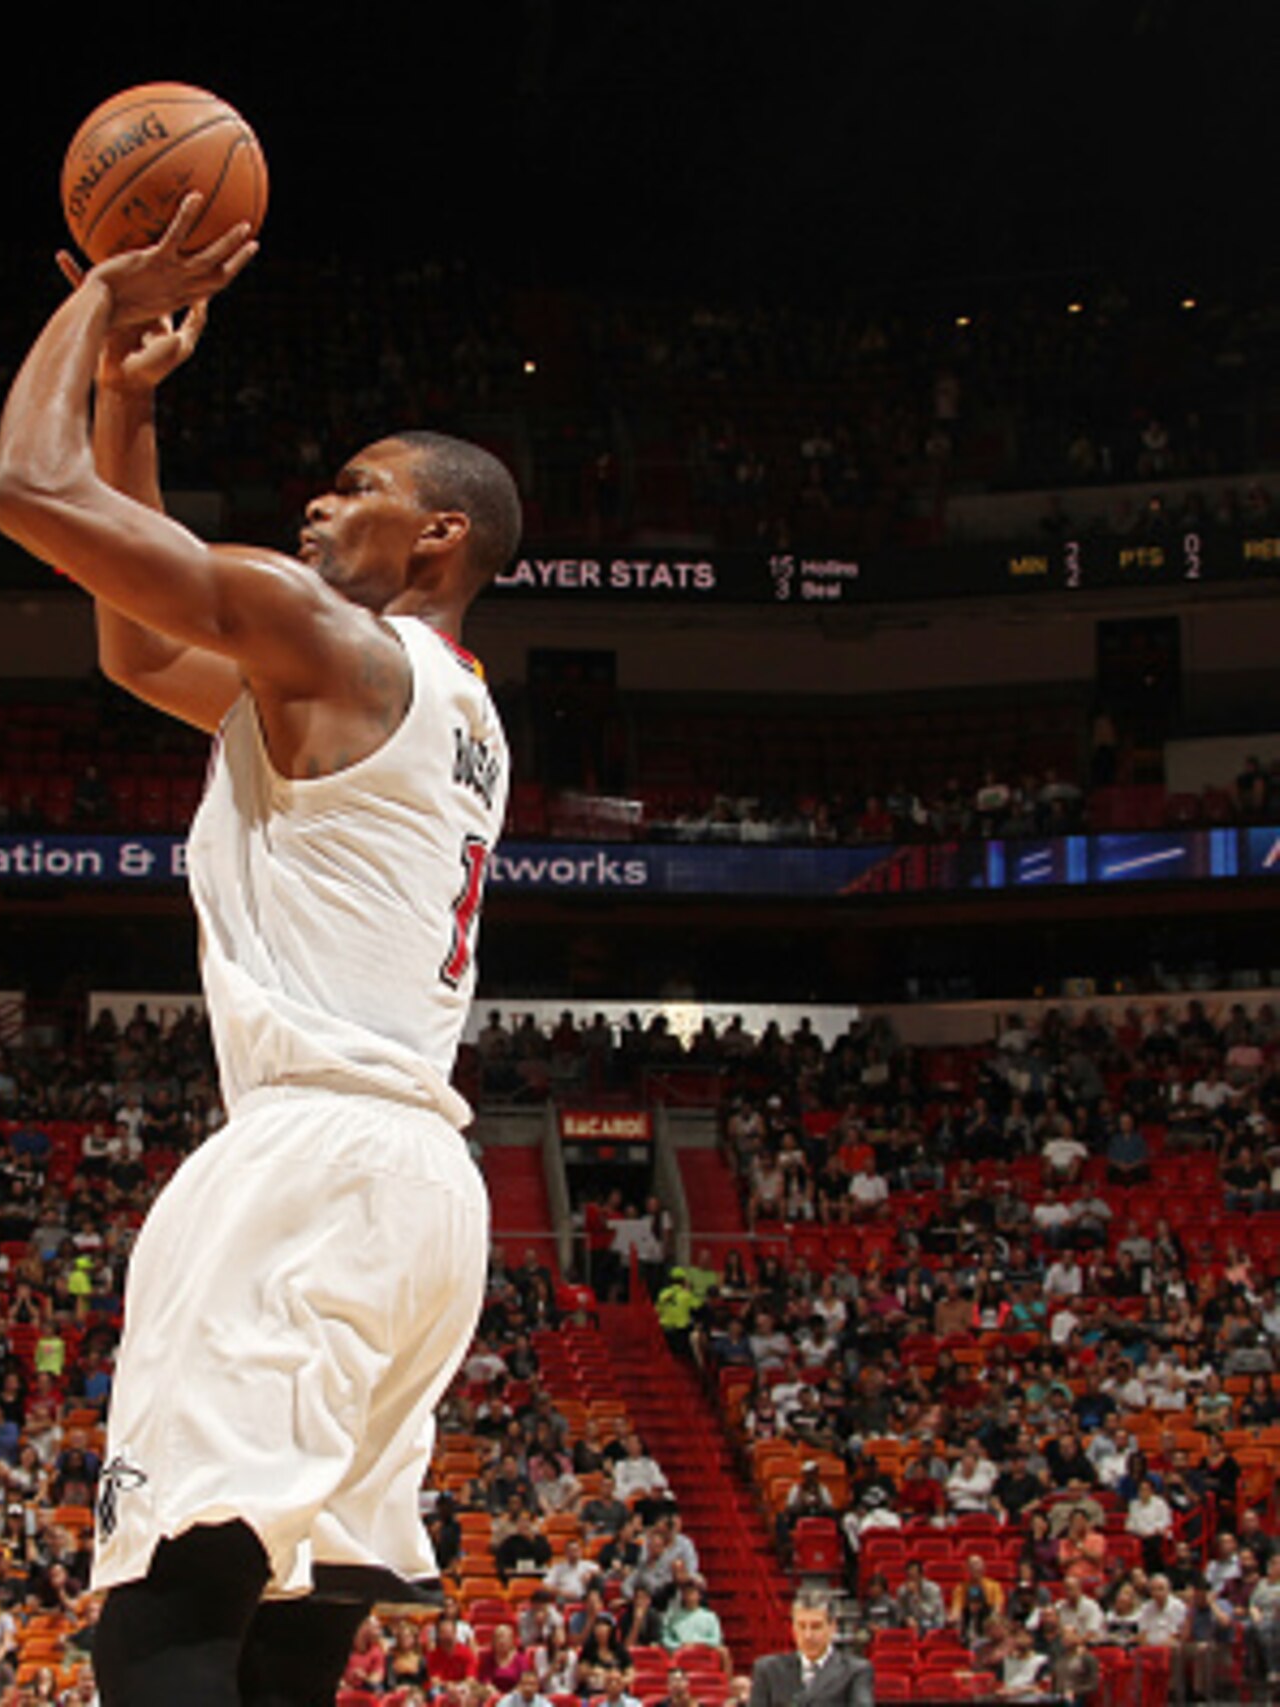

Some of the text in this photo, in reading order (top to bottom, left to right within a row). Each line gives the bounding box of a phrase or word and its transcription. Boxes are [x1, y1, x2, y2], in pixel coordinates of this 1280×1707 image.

[68, 111, 169, 217] PALDING
[1184, 532, 1201, 553] 0
[493, 559, 716, 588] LAYER STATS
[1184, 553, 1201, 579] 2
[118, 845, 156, 876] &
[488, 851, 648, 886] tworks
[439, 833, 488, 992] 1
